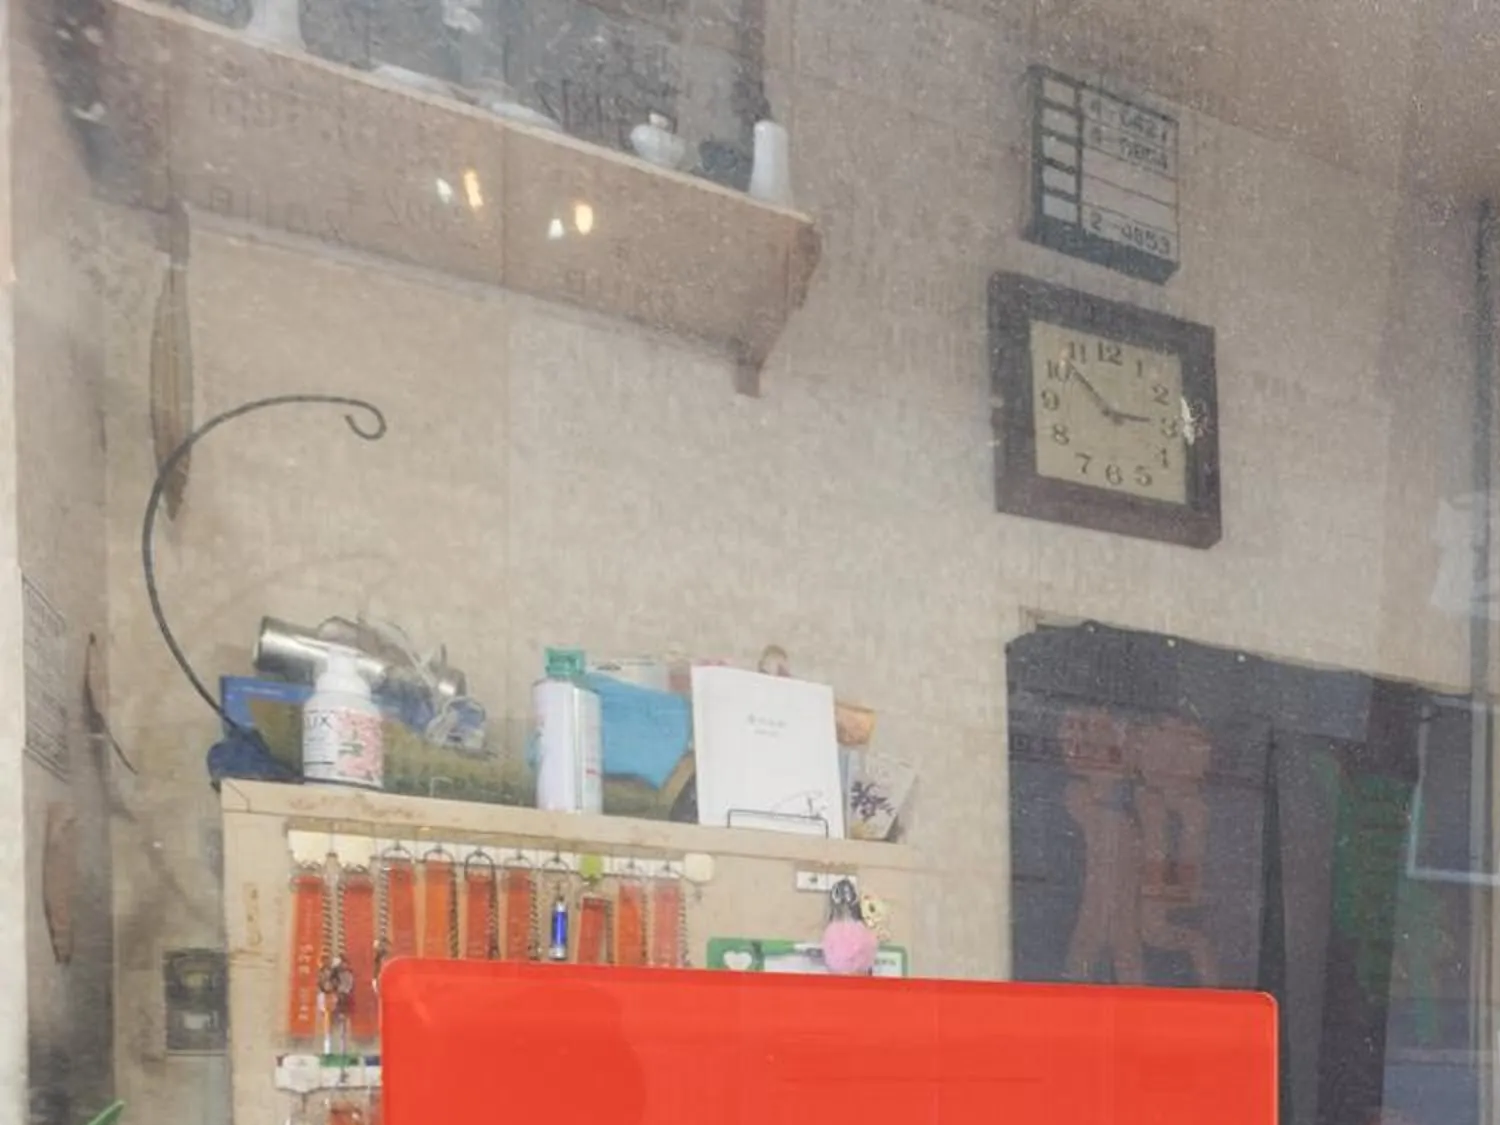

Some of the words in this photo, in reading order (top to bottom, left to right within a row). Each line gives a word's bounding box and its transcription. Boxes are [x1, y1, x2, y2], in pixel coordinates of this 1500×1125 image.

[1069, 341, 1086, 364] 11
[1098, 342, 1122, 366] 12
[1041, 389, 1060, 411] 9
[1152, 385, 1169, 406] 2
[1053, 424, 1070, 445] 8
[1075, 452, 1091, 474] 7
[1105, 464, 1123, 485] 6
[1134, 465, 1152, 486] 5
